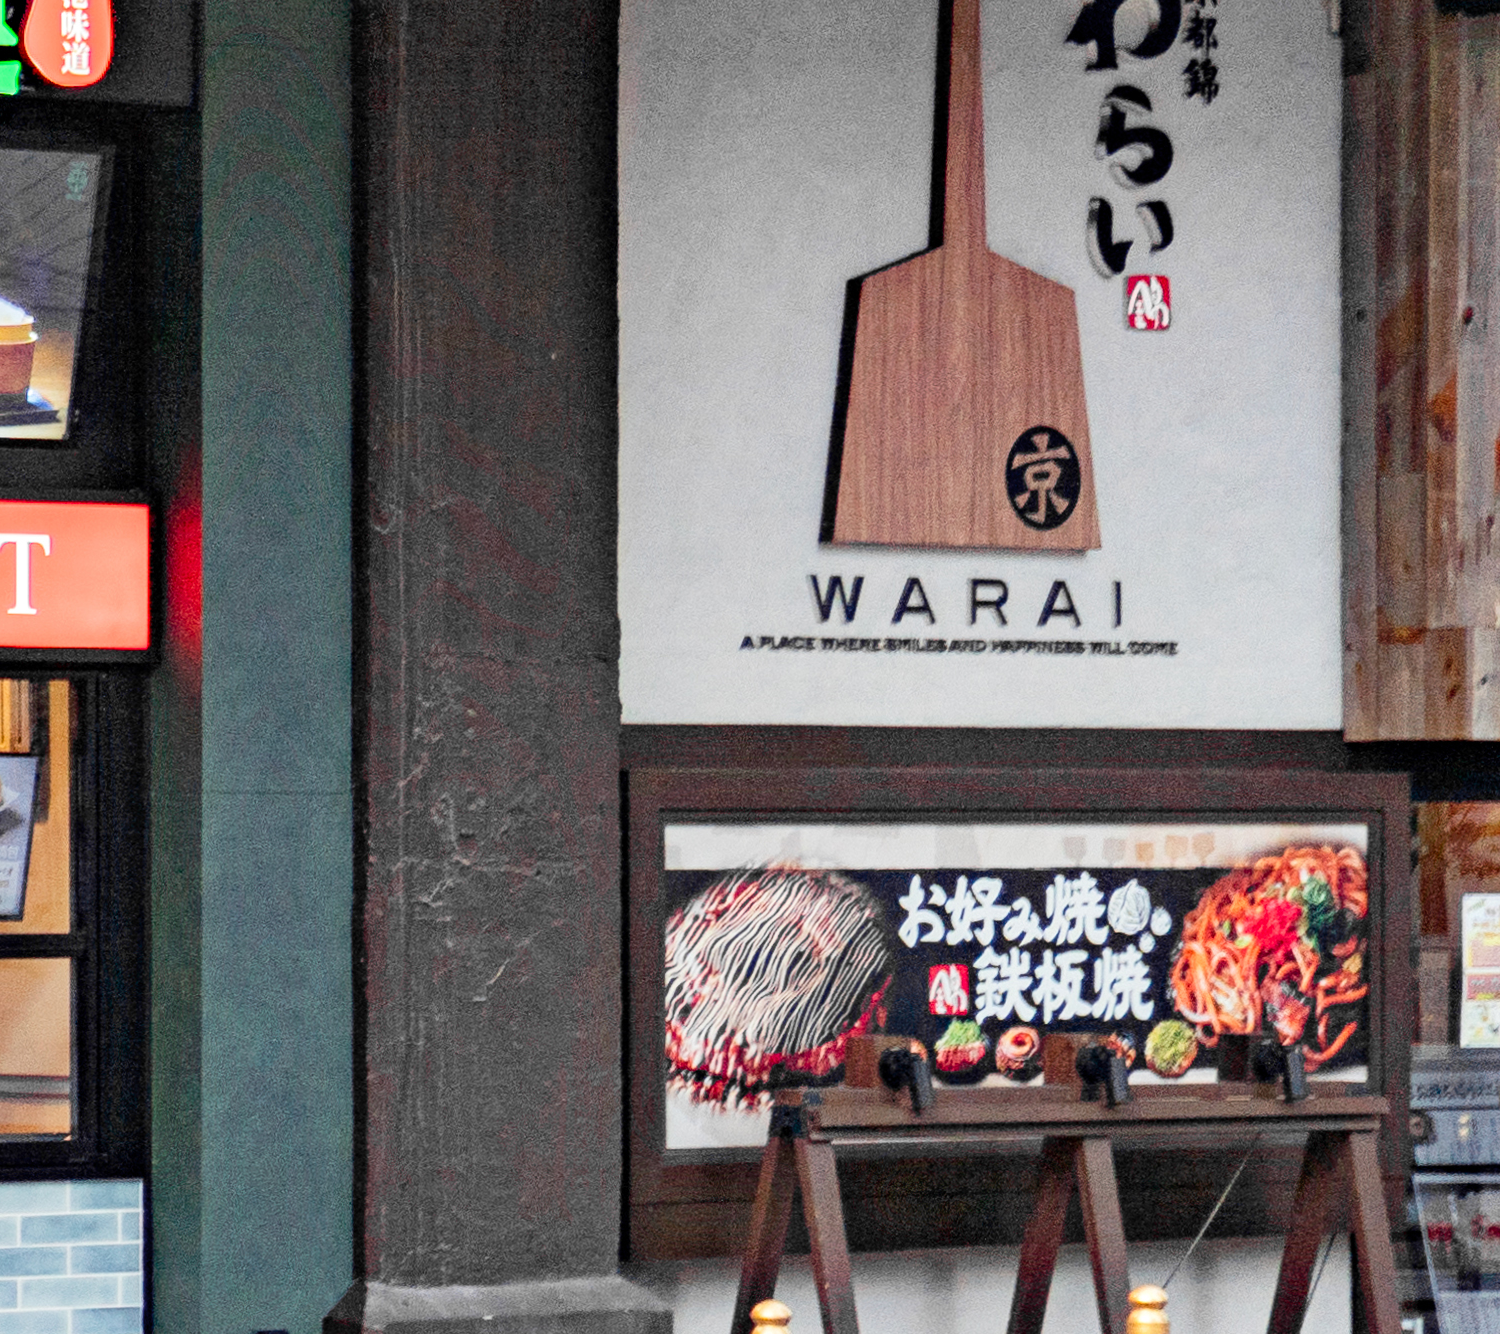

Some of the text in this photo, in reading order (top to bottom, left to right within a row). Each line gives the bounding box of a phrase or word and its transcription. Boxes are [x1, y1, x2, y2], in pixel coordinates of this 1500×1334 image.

[1011, 432, 1072, 524] 京
[808, 574, 1122, 628] WARAI
[740, 635, 755, 650] A
[758, 636, 814, 652] PLACE
[820, 637, 881, 653] WHERE
[948, 639, 987, 654] AND
[1089, 641, 1126, 656] WILL
[898, 870, 1110, 949] お好み焼
[973, 944, 1155, 1026] 鉄板焼
